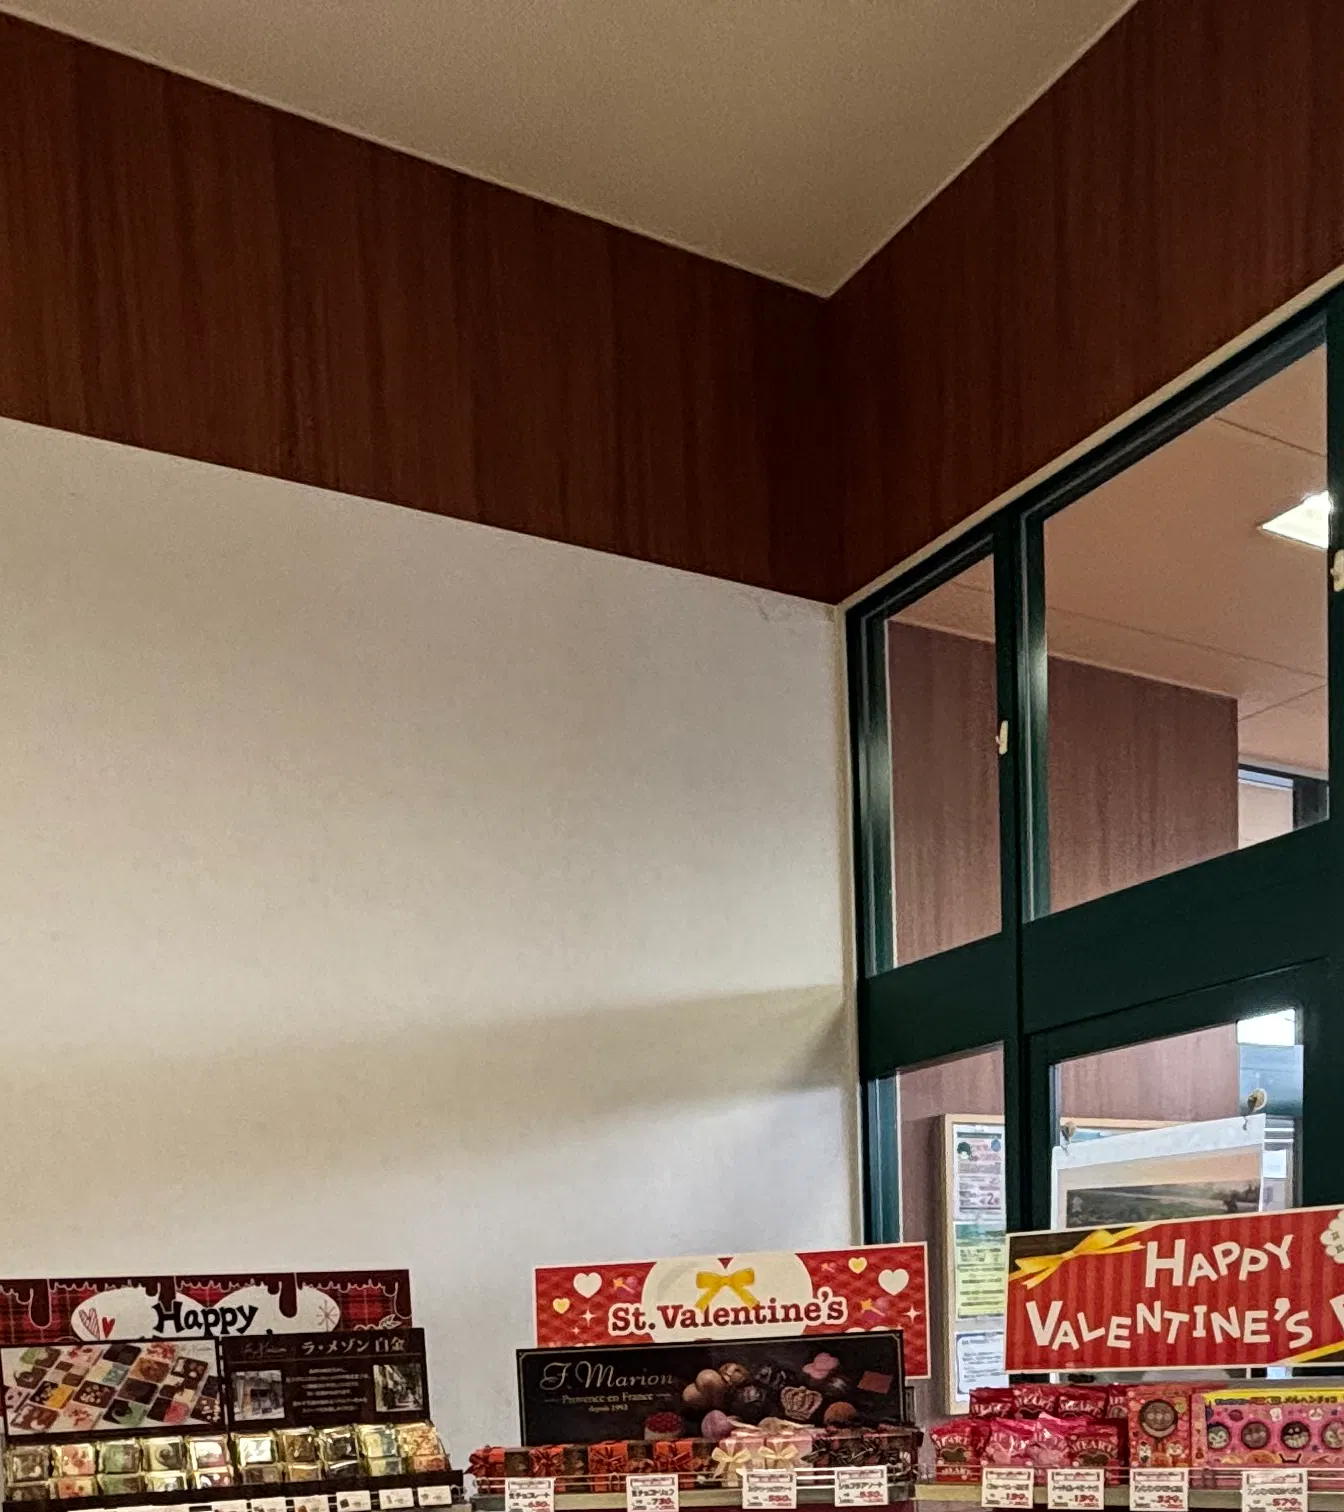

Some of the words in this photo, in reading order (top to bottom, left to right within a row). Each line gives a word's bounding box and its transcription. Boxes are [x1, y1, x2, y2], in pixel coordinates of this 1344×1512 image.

[1144, 1233, 1295, 1289] HAPPY
[152, 1301, 259, 1337] Happy
[608, 1305, 657, 1334] St.
[657, 1289, 846, 1330] Valentine's
[574, 1359, 674, 1389] Marion
